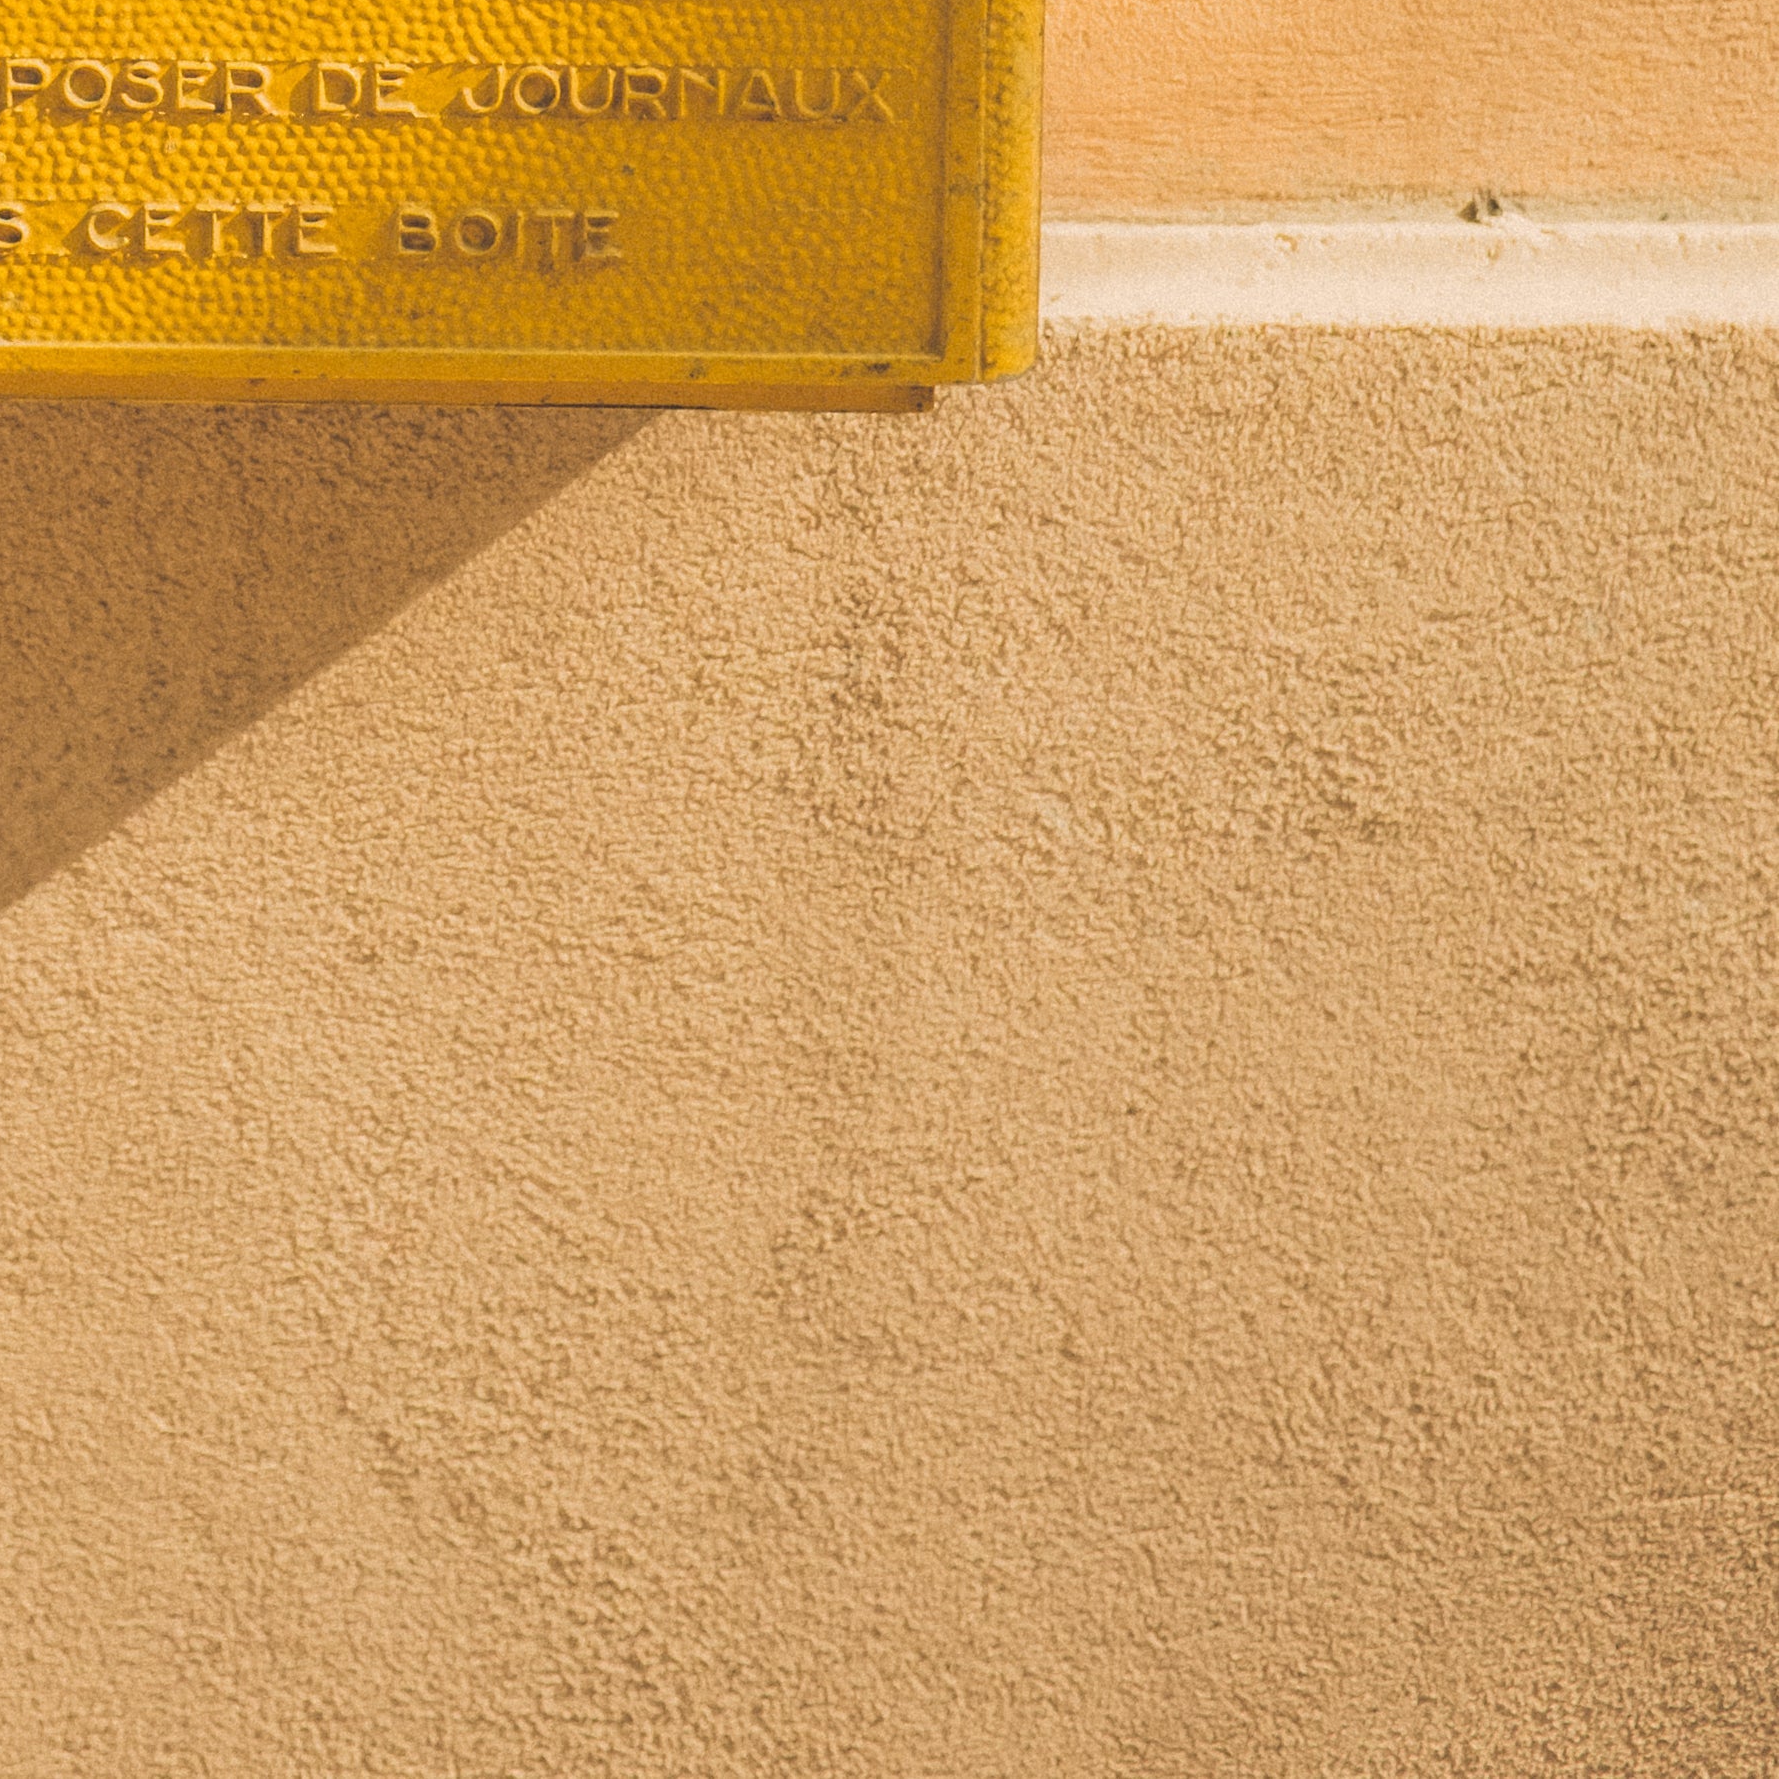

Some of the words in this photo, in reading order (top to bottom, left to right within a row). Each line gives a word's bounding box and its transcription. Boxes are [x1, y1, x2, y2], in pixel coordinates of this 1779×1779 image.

[314, 61, 418, 114] DE
[461, 63, 897, 123] JOURNAUX
[86, 201, 338, 255] CETTE
[397, 208, 621, 257] BOITE
